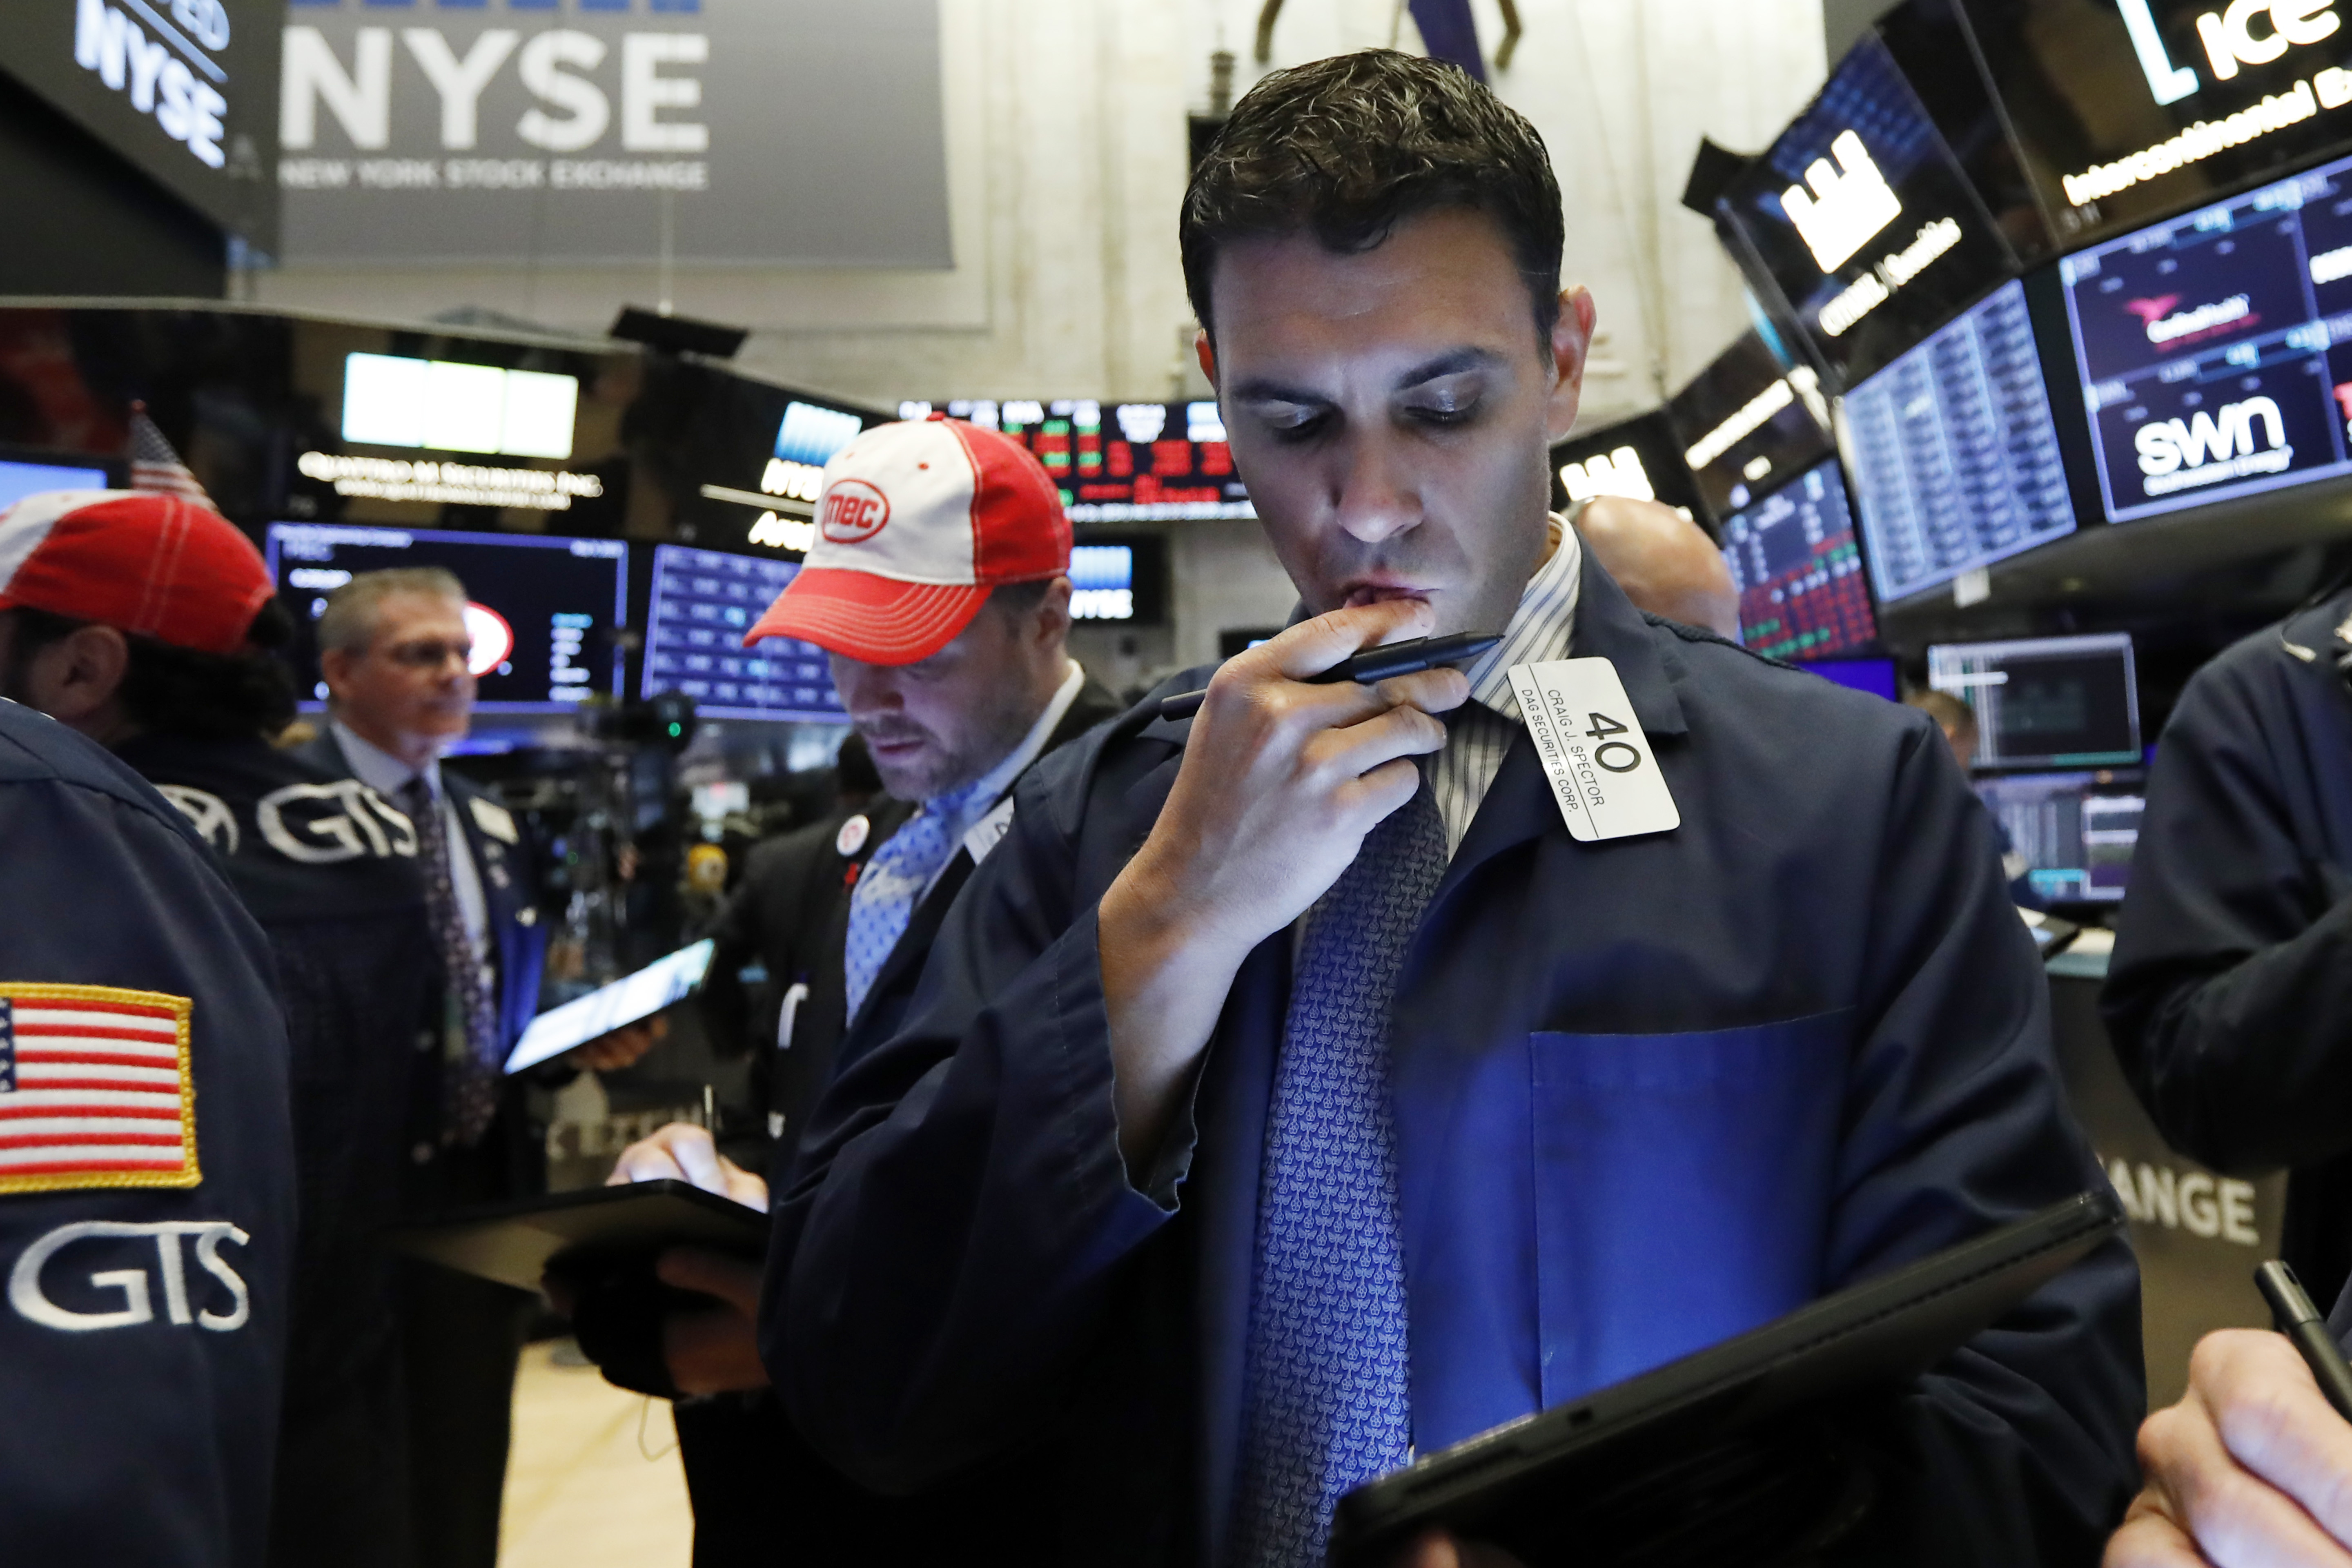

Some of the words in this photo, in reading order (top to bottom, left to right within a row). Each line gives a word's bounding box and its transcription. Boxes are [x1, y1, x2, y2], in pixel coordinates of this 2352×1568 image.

[75, 0, 227, 168] NYSE
[280, 25, 710, 152] NYSE
[278, 160, 348, 189] NEW
[358, 160, 438, 189] YORK
[444, 160, 544, 189] STOCK
[549, 160, 708, 190] EXCHANGE
[1521, 689, 1539, 711] DAG
[1532, 715, 1565, 775] SECURITIES
[1558, 779, 1578, 812] CORP.
[1548, 690, 1572, 726] CRAIG
[1564, 731, 1578, 742] J.
[1571, 746, 1605, 806] SPECTOR
[1586, 712, 1642, 773] 40
[256, 779, 418, 864] GTS
[2095, 1152, 2261, 1247] ANGE
[8, 1220, 251, 1332] GTS
